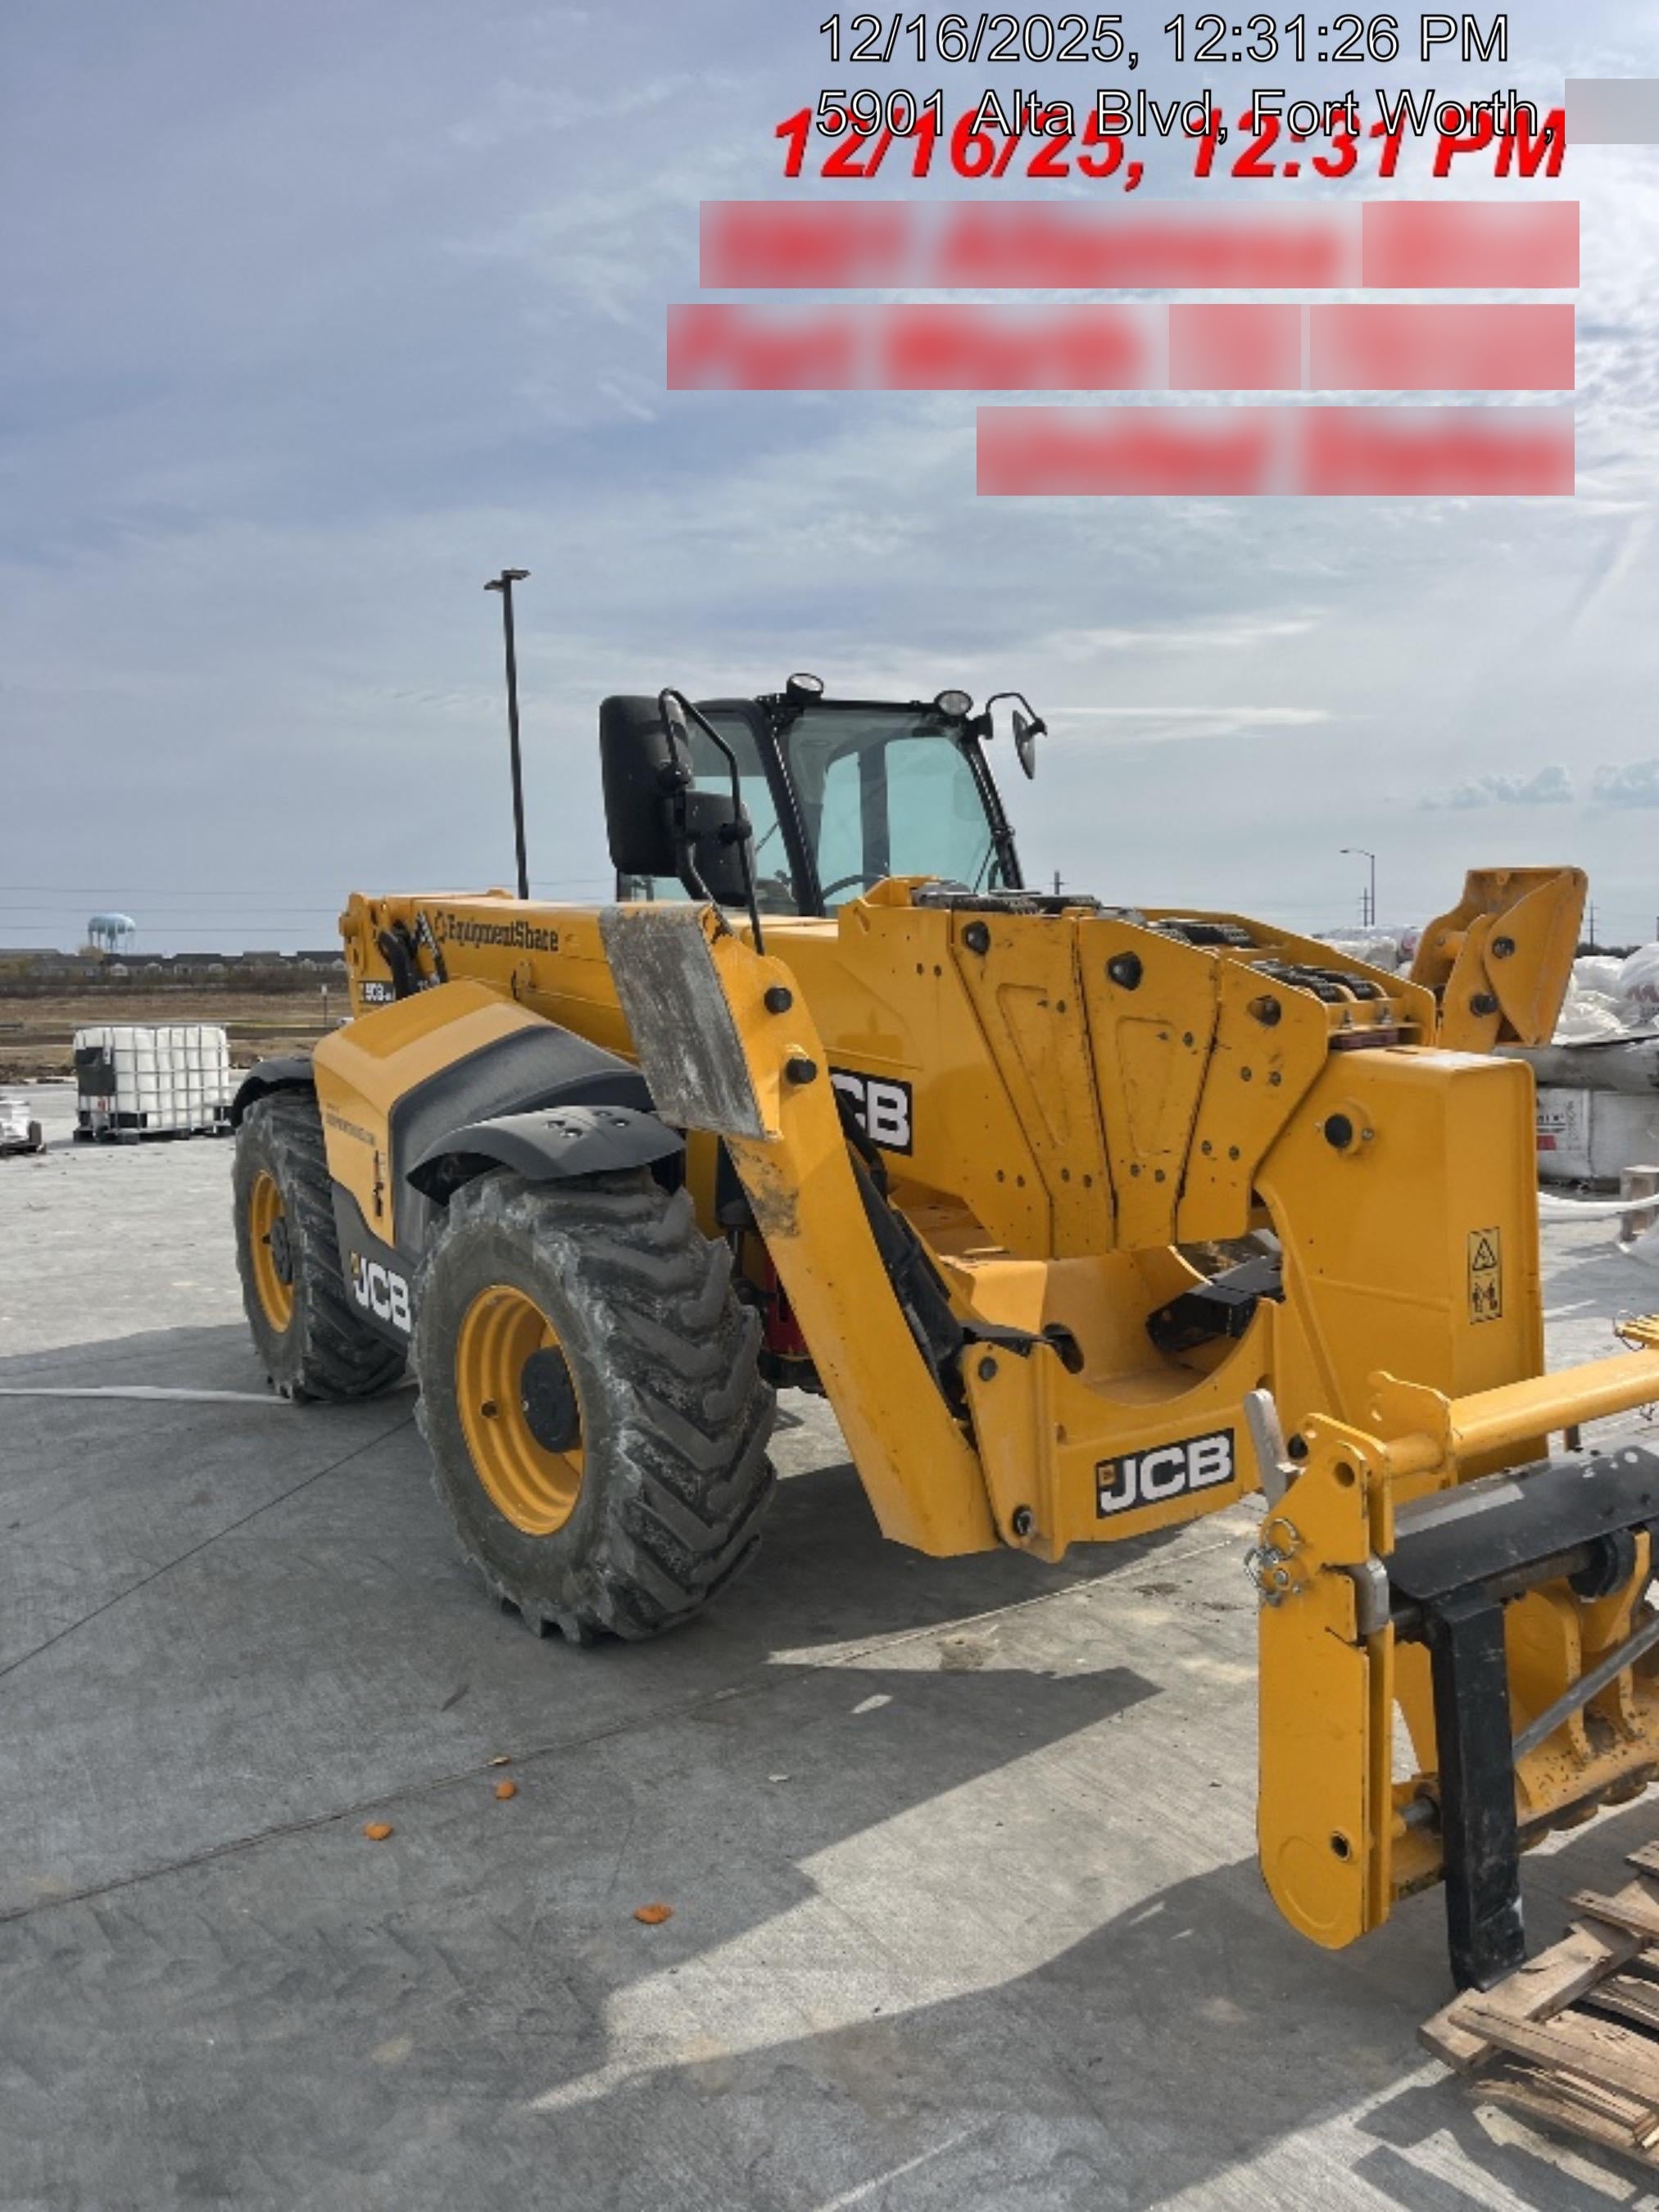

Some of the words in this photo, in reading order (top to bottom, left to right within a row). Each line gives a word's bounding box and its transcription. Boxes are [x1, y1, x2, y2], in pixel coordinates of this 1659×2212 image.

[448, 913, 559, 952] EquipmentShare
[352, 1257, 411, 1333] JCB
[1100, 1435, 1232, 1512] JCB
